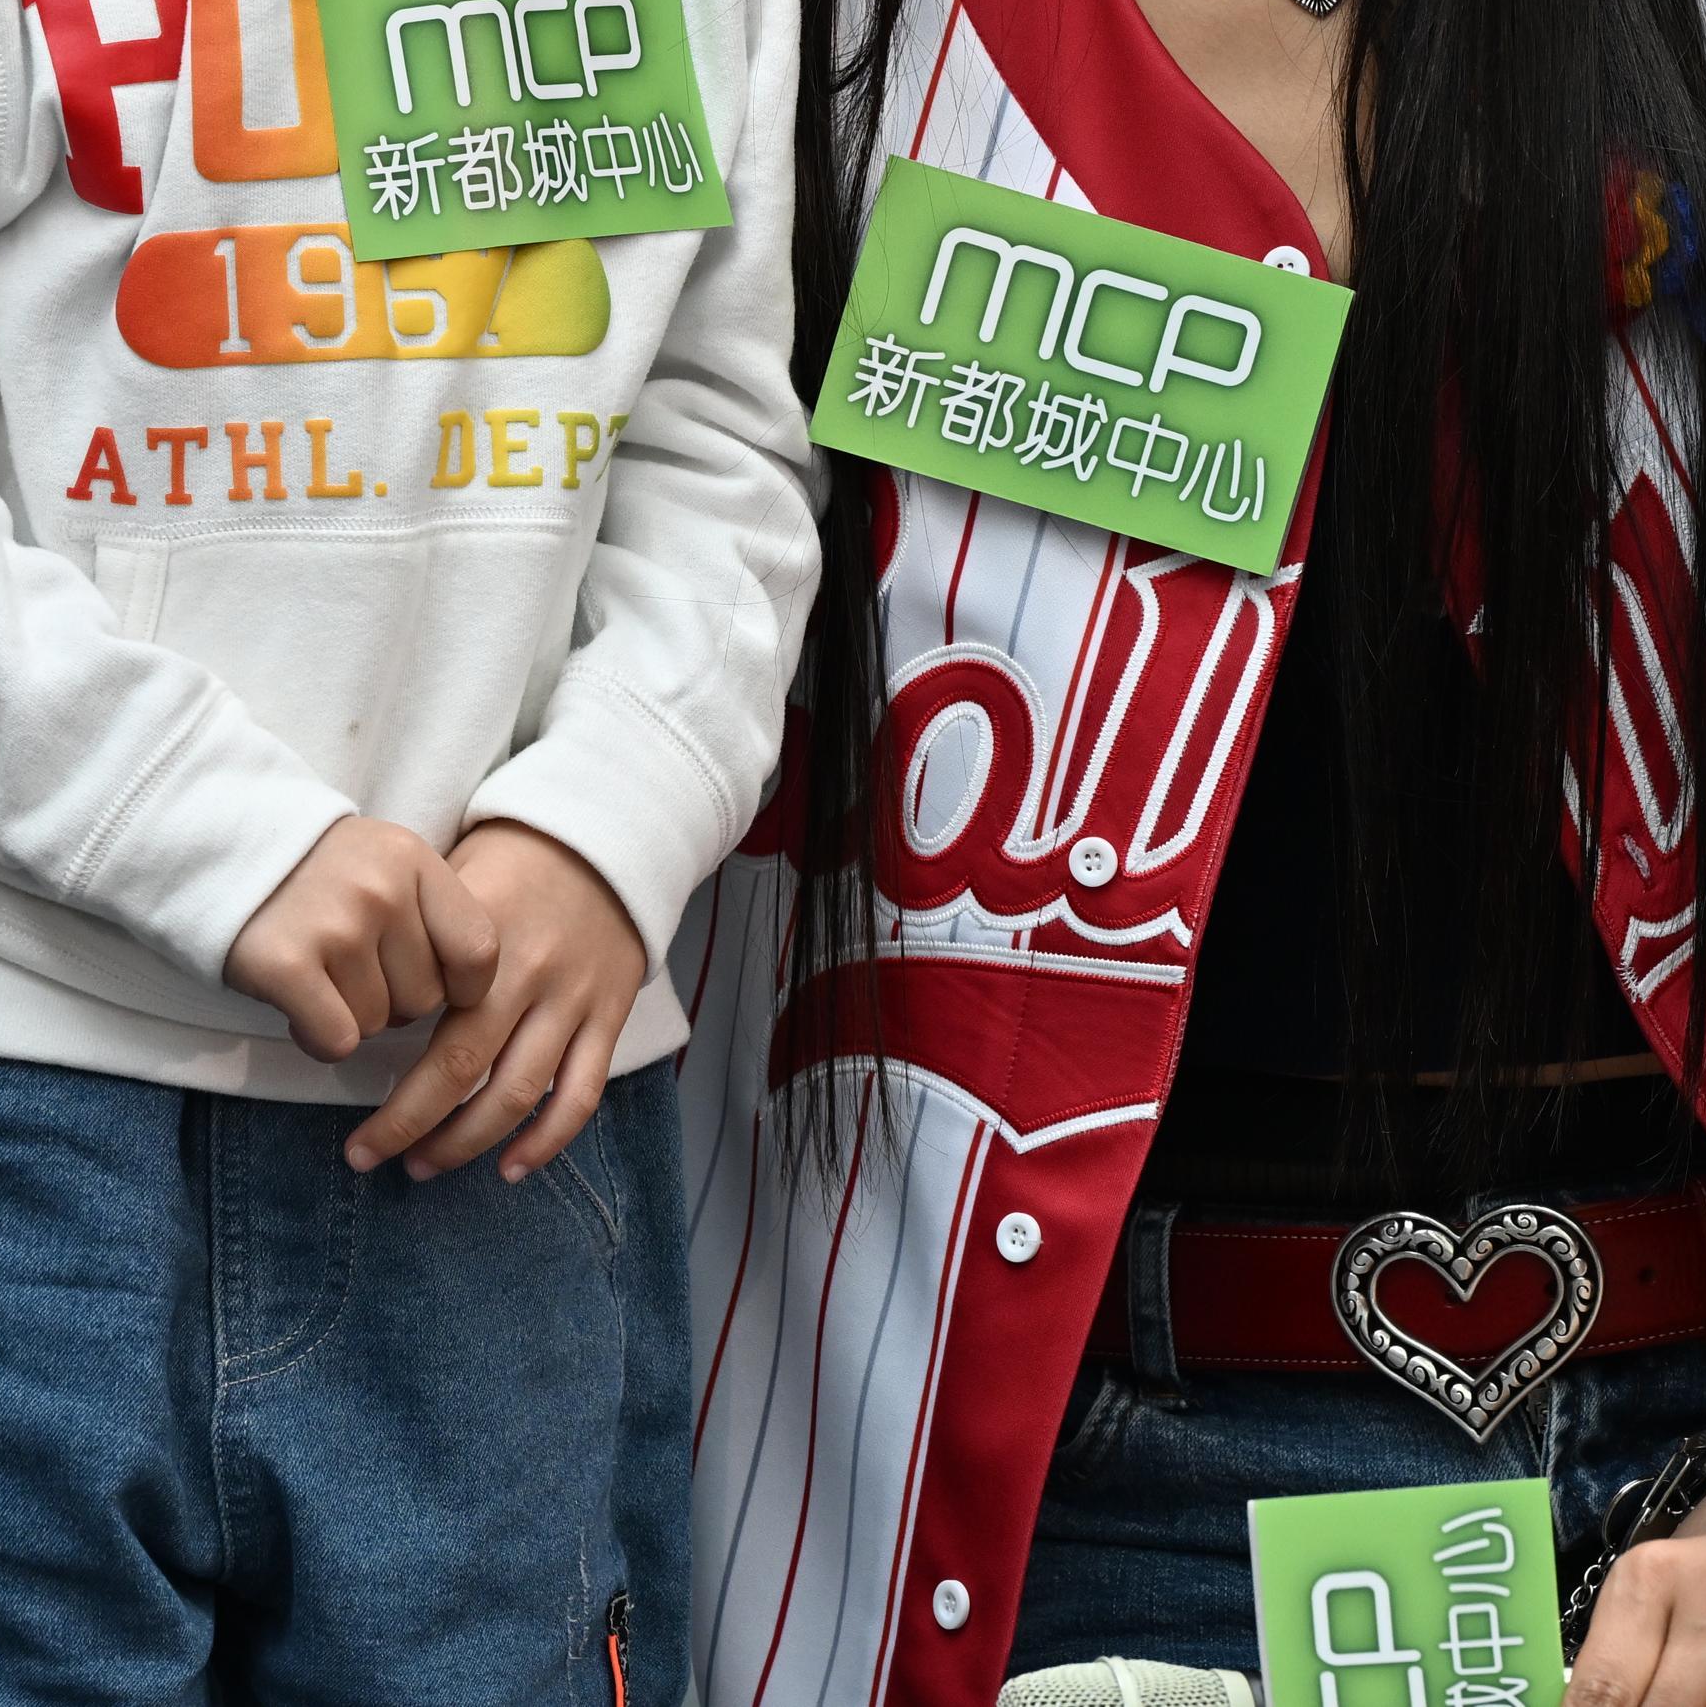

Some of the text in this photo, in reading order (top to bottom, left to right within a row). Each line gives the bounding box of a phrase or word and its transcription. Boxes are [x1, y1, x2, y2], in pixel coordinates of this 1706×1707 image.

[363, 111, 705, 221] 新都城中心
[66, 418, 389, 506] ATHL.
[847, 333, 1265, 523] 新都城中心
